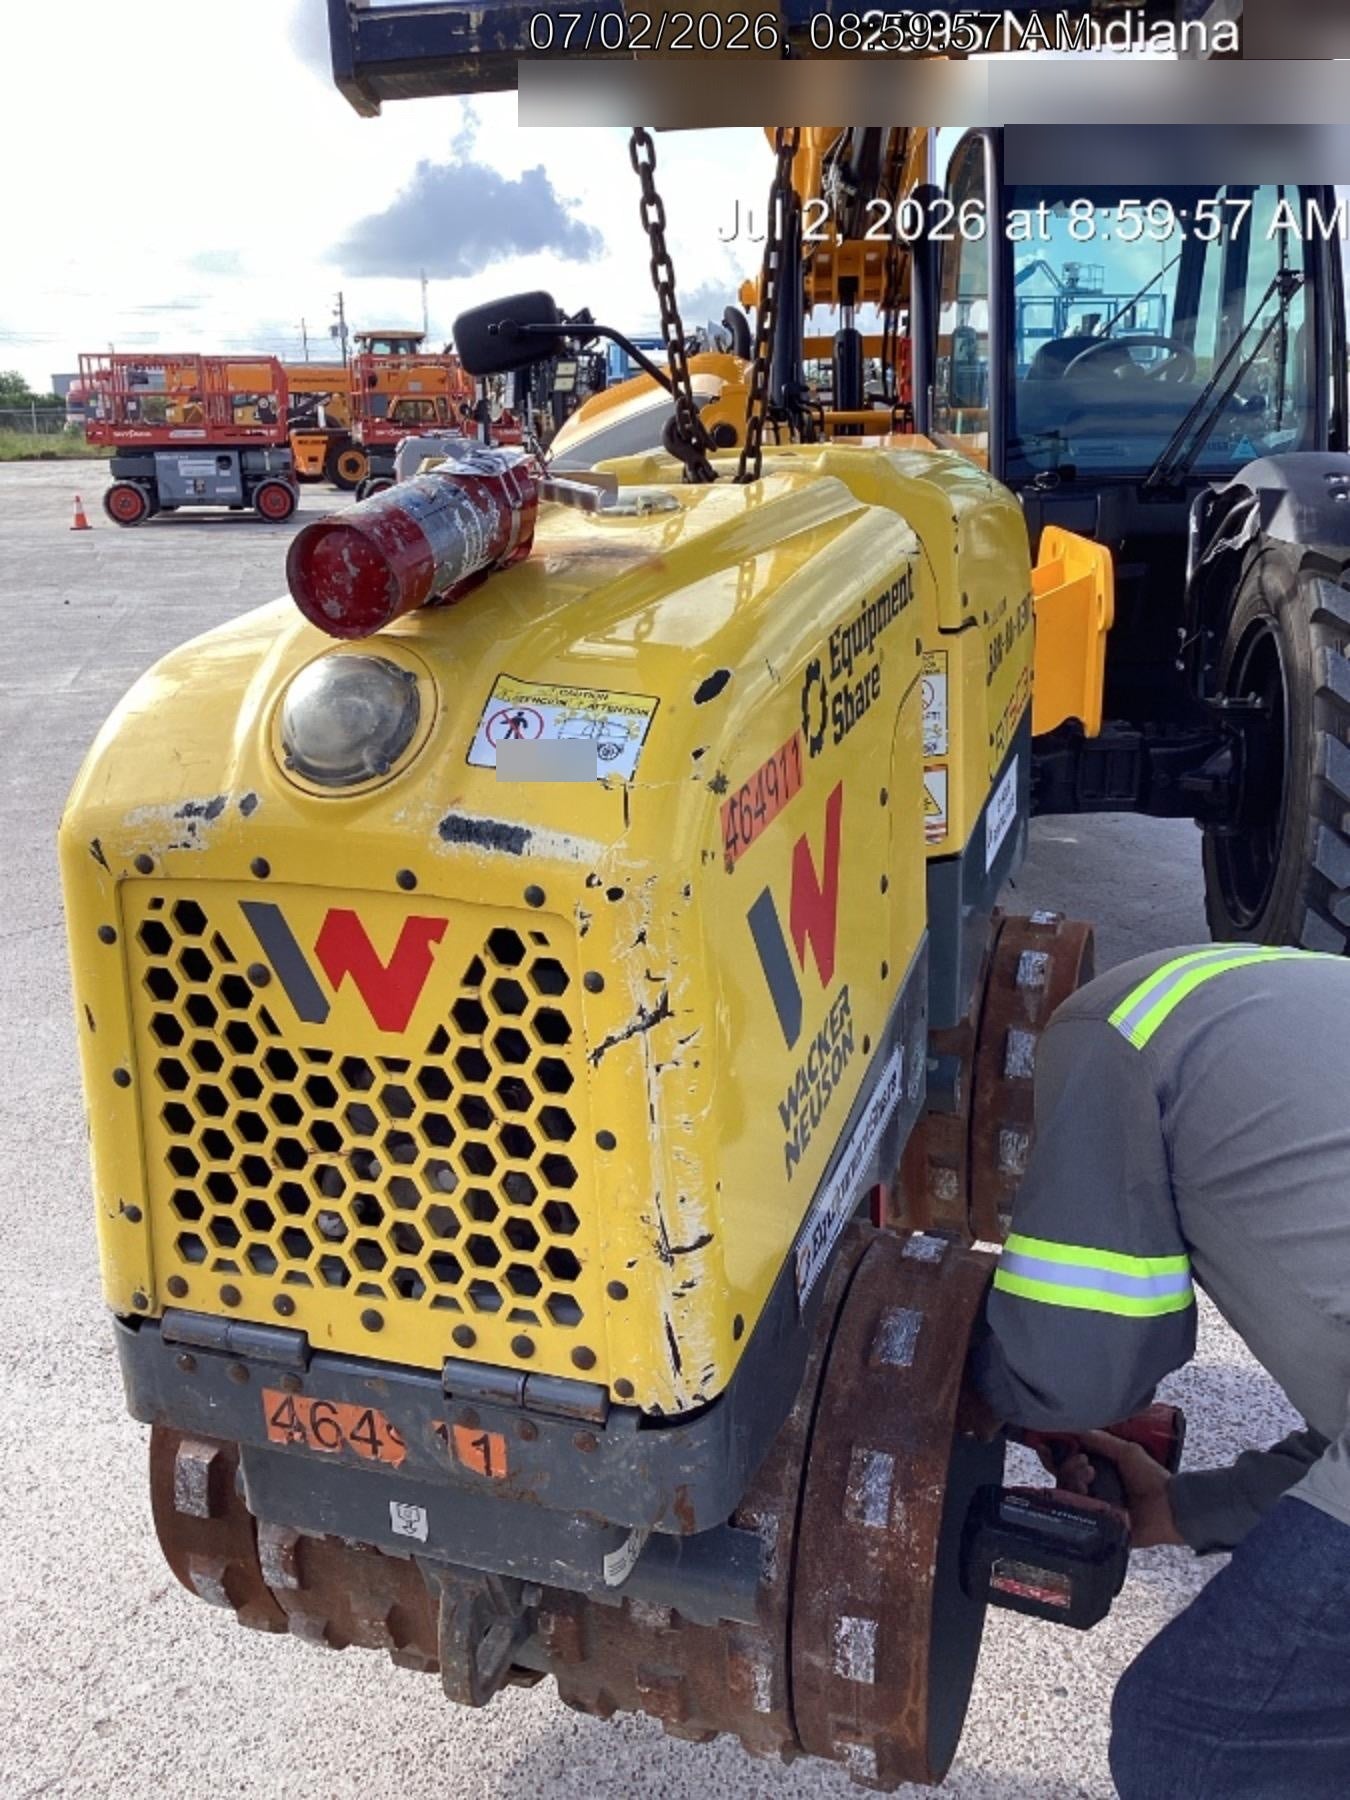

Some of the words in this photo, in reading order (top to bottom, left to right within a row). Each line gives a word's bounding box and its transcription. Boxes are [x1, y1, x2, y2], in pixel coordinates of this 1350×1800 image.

[828, 562, 915, 682] Equipment
[723, 743, 803, 855] 464911
[778, 984, 852, 1133] WACKER
[784, 1018, 855, 1183] NEUSON
